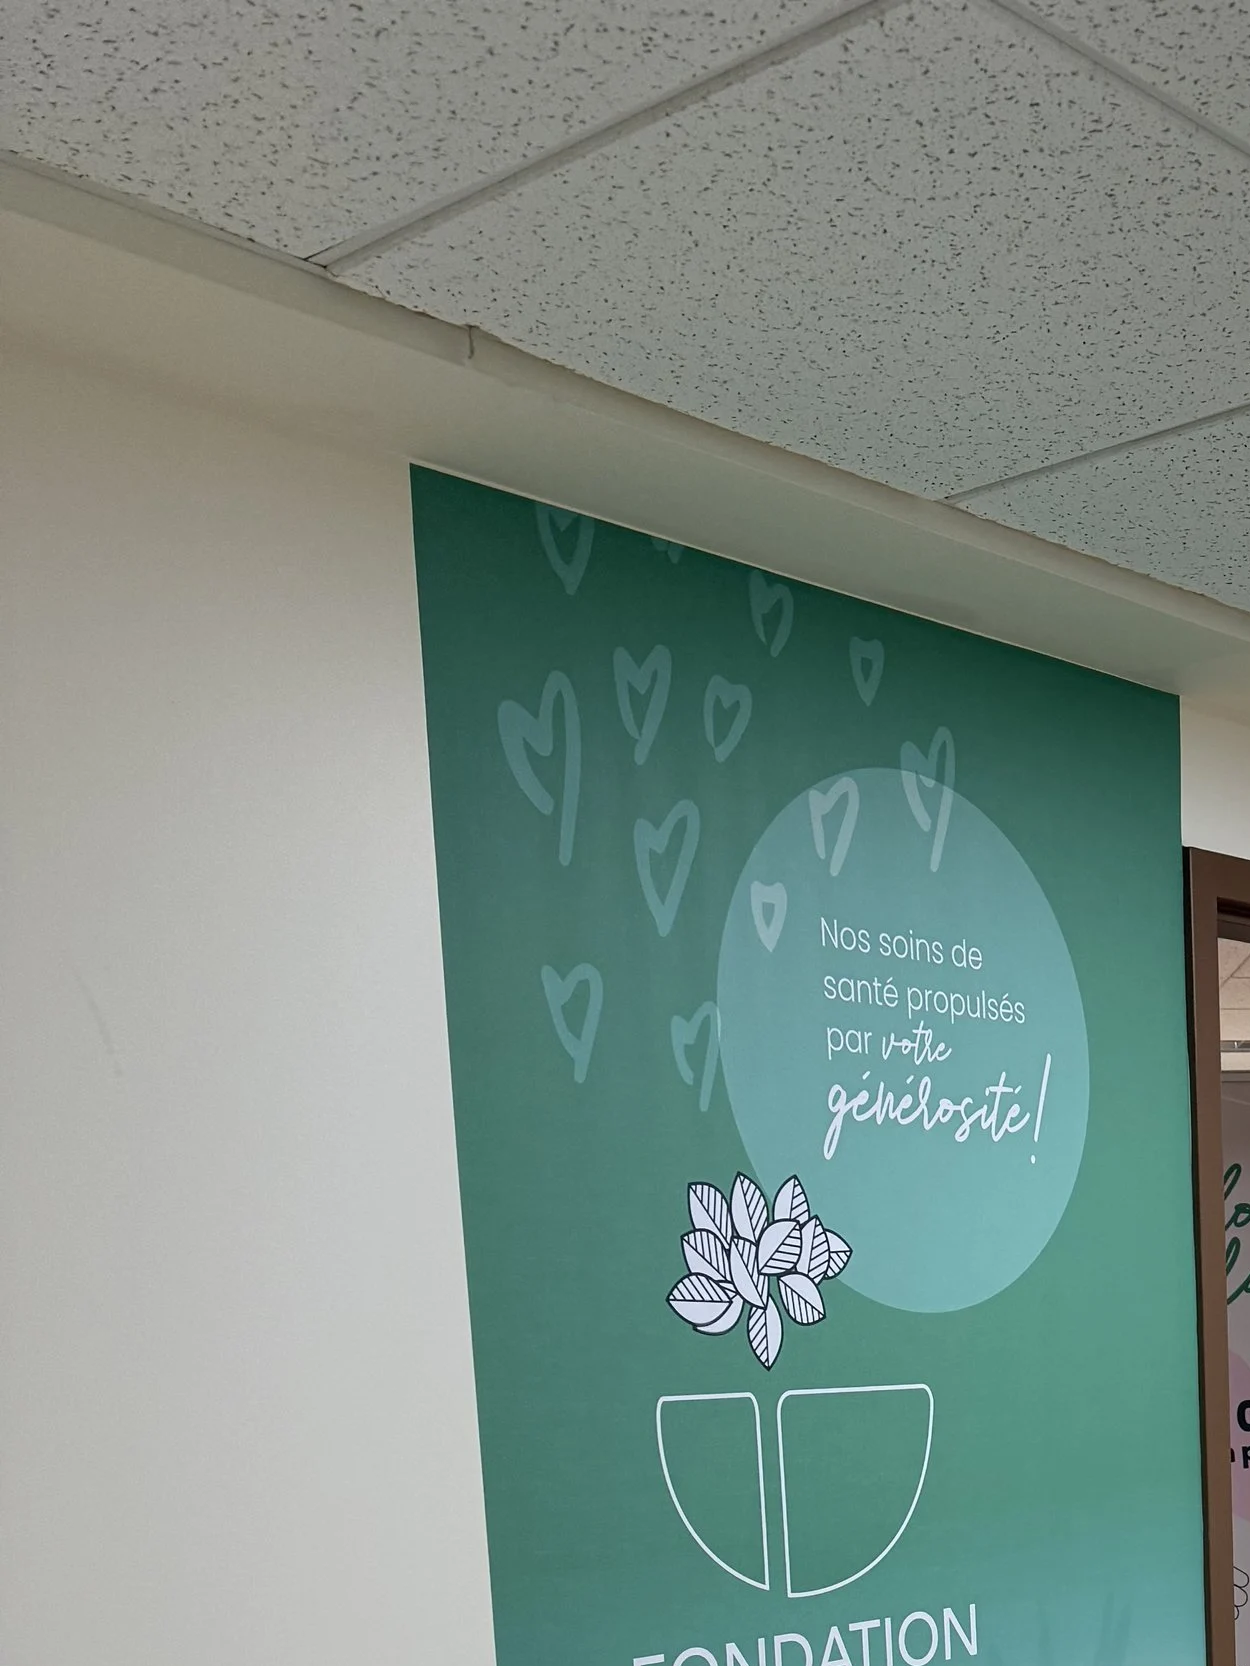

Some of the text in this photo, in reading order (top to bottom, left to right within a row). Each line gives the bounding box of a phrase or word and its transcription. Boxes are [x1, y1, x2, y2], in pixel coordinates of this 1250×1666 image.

[820, 916, 983, 970] Nos soins de
[823, 975, 1026, 1025] santé propulsés
[827, 1020, 953, 1066] par votre
[823, 1053, 1052, 1165] générosité!
